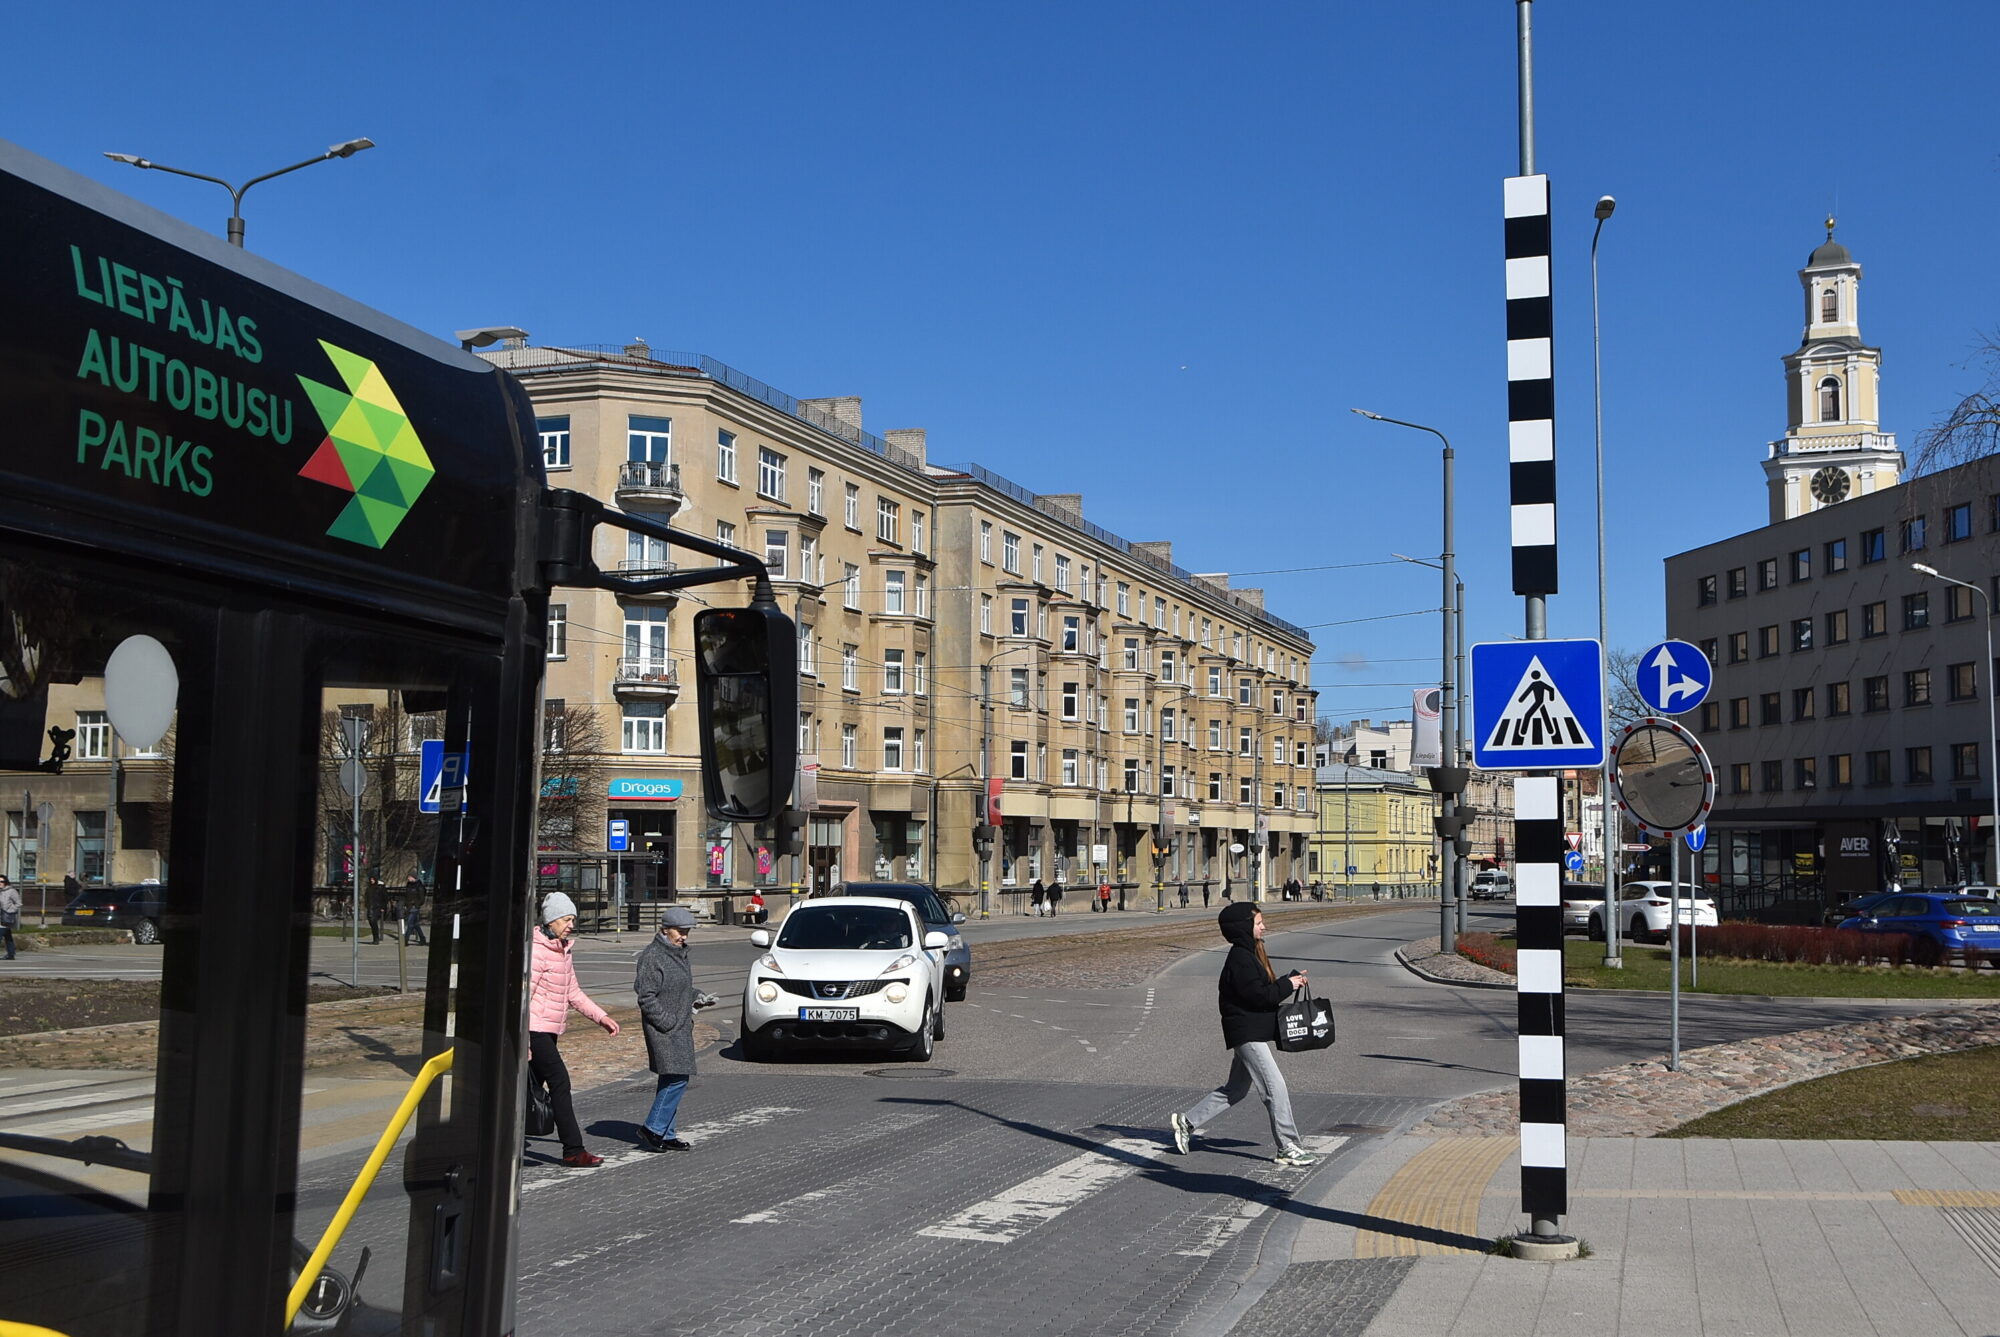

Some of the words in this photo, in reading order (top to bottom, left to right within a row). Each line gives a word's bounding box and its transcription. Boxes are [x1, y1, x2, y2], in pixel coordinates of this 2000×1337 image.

[70, 244, 263, 363] LIEPĀJAS
[77, 328, 293, 445] AUTOBUSU
[77, 408, 214, 497] PARKS
[621, 782, 672, 795] Drogas
[1840, 837, 1869, 851] AVER
[1286, 1014, 1303, 1022] LOVE
